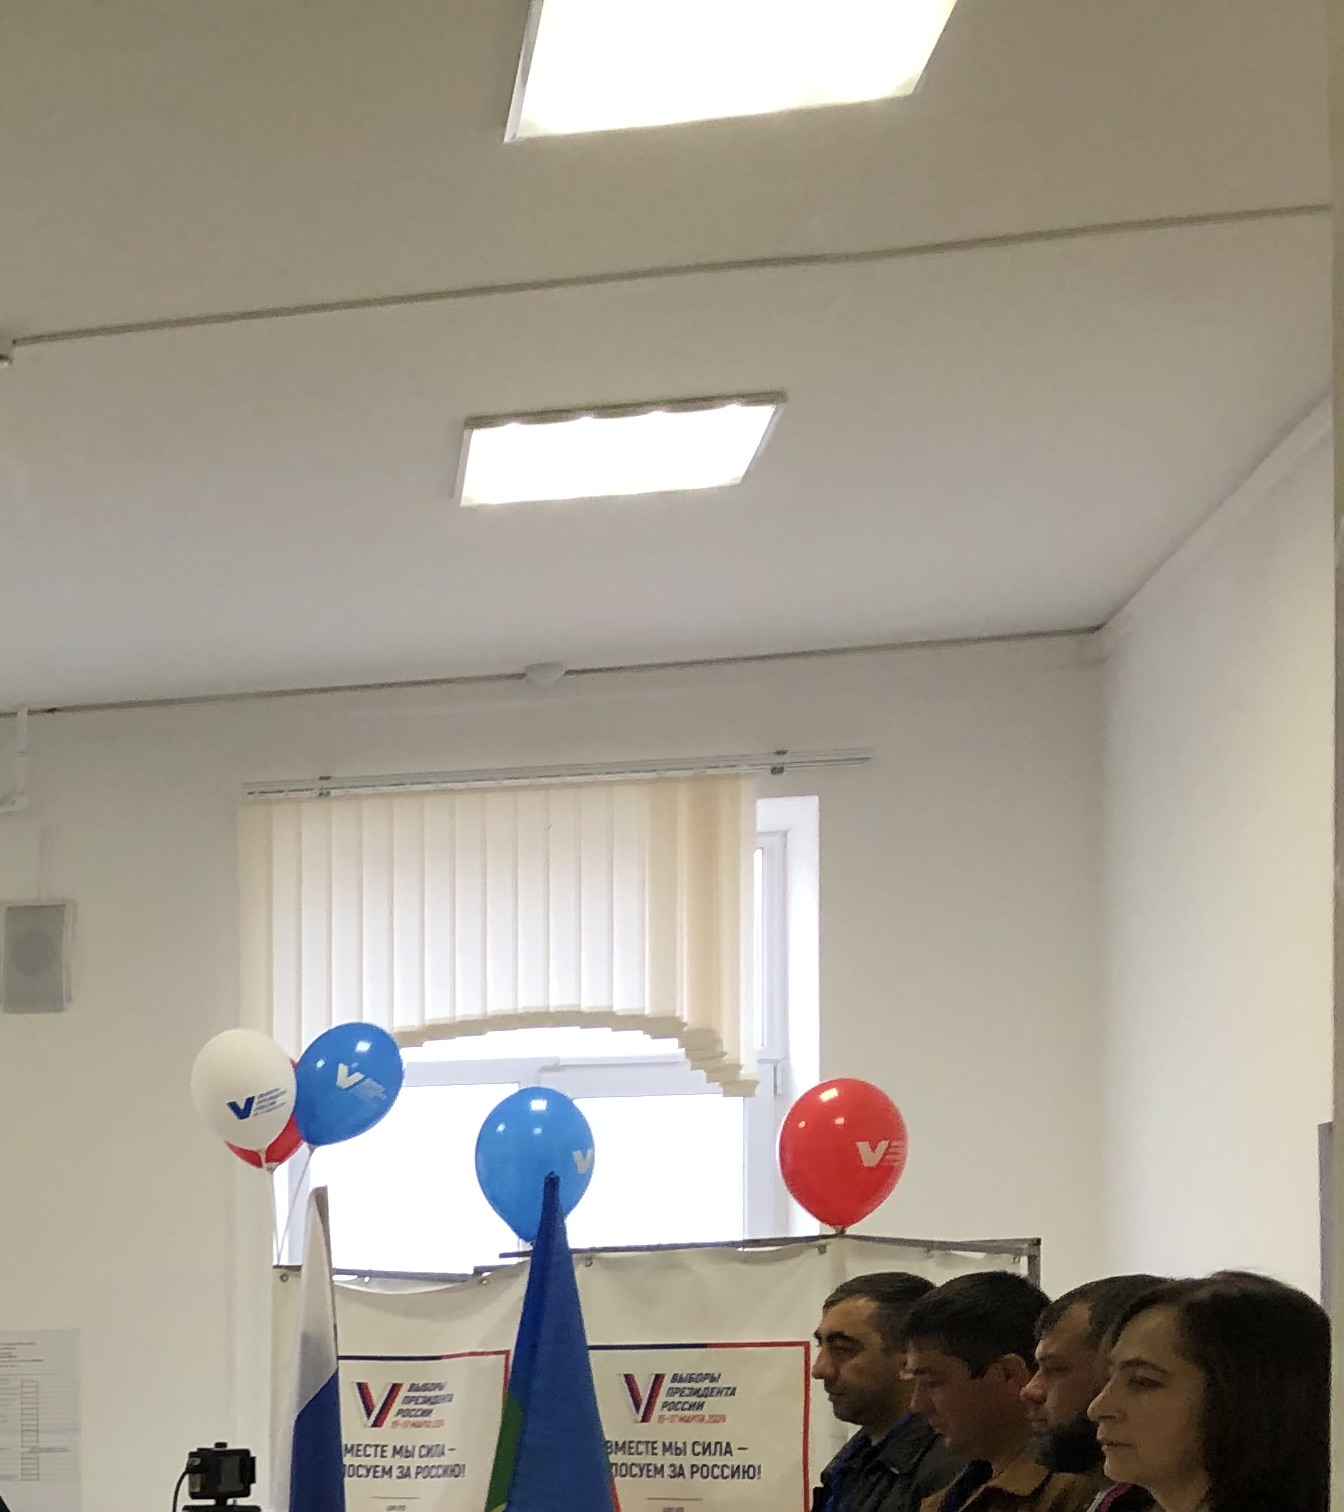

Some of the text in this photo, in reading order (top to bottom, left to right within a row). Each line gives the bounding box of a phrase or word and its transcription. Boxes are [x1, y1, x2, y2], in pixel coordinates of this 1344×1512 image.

[670, 1372, 722, 1384] ВЫБОРЫ
[665, 1386, 738, 1398] ПРЕЗИДЕНТА
[401, 1393, 454, 1405] ПРЕЗИД
[660, 1401, 706, 1411] РОССИИ
[344, 1443, 388, 1458] МЕСТЕ
[391, 1444, 415, 1458] МЫ
[418, 1443, 445, 1458] СИЛА
[662, 1440, 687, 1456] МЫ
[691, 1440, 734, 1457] СИЛА
[345, 1463, 466, 1479] ОСУЕМ ЗА РОССИЮ!
[611, 1462, 762, 1480] ЛОСУЕМ ЗА РОССИЮ!
